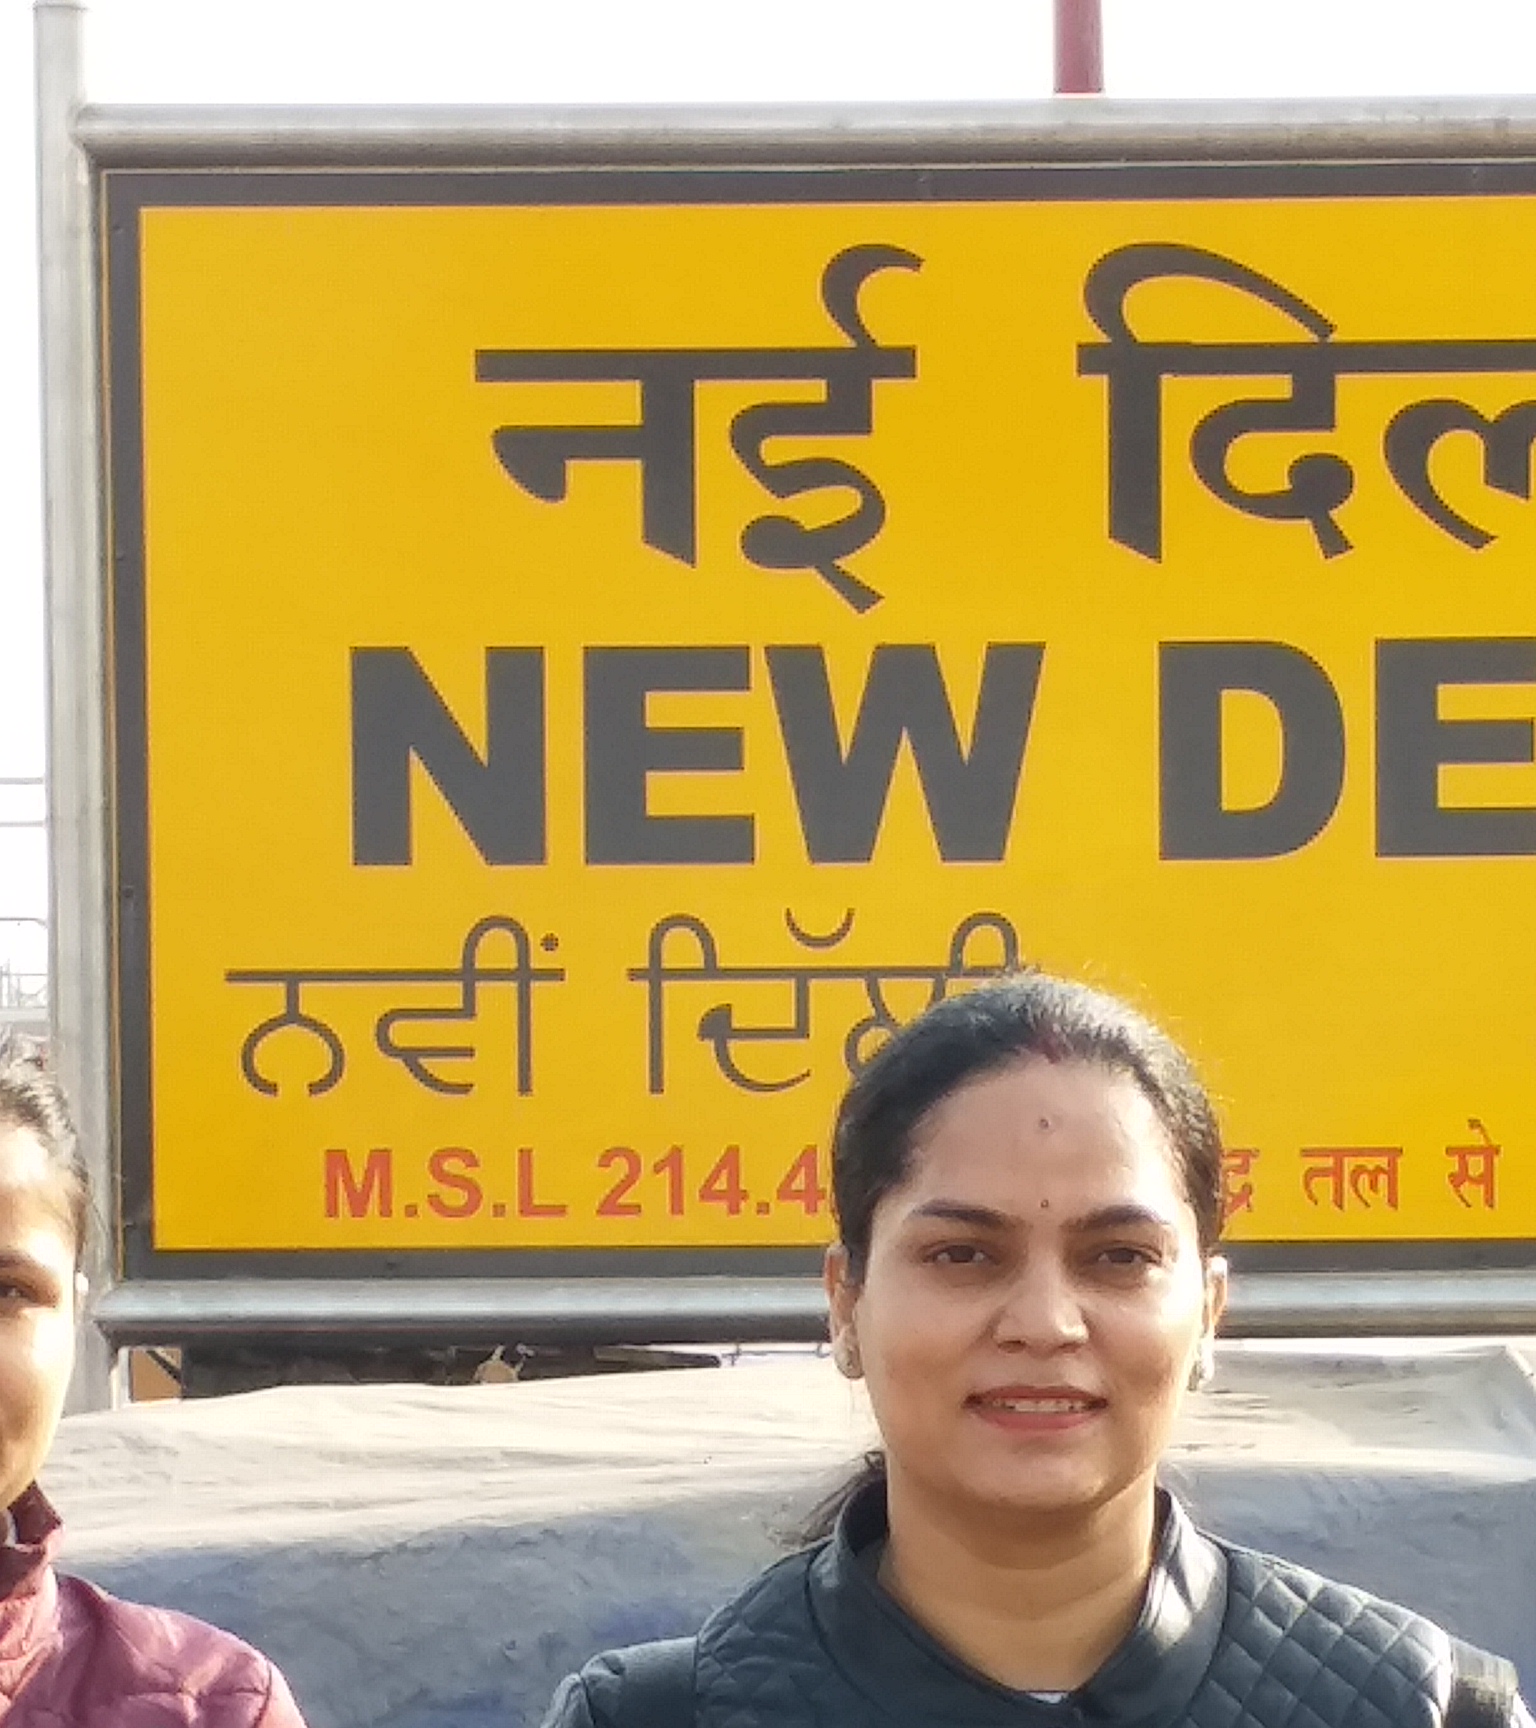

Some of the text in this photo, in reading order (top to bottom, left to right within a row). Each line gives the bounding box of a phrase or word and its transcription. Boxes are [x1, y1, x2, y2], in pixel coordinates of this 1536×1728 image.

[475, 242, 924, 614] नई
[350, 641, 1046, 867] NEW
[224, 915, 566, 1097] ਨਵੀਂ
[323, 1143, 828, 1219] M.S.L 214.4
[1300, 1146, 1404, 1211] तल
[1444, 1118, 1502, 1210] से
